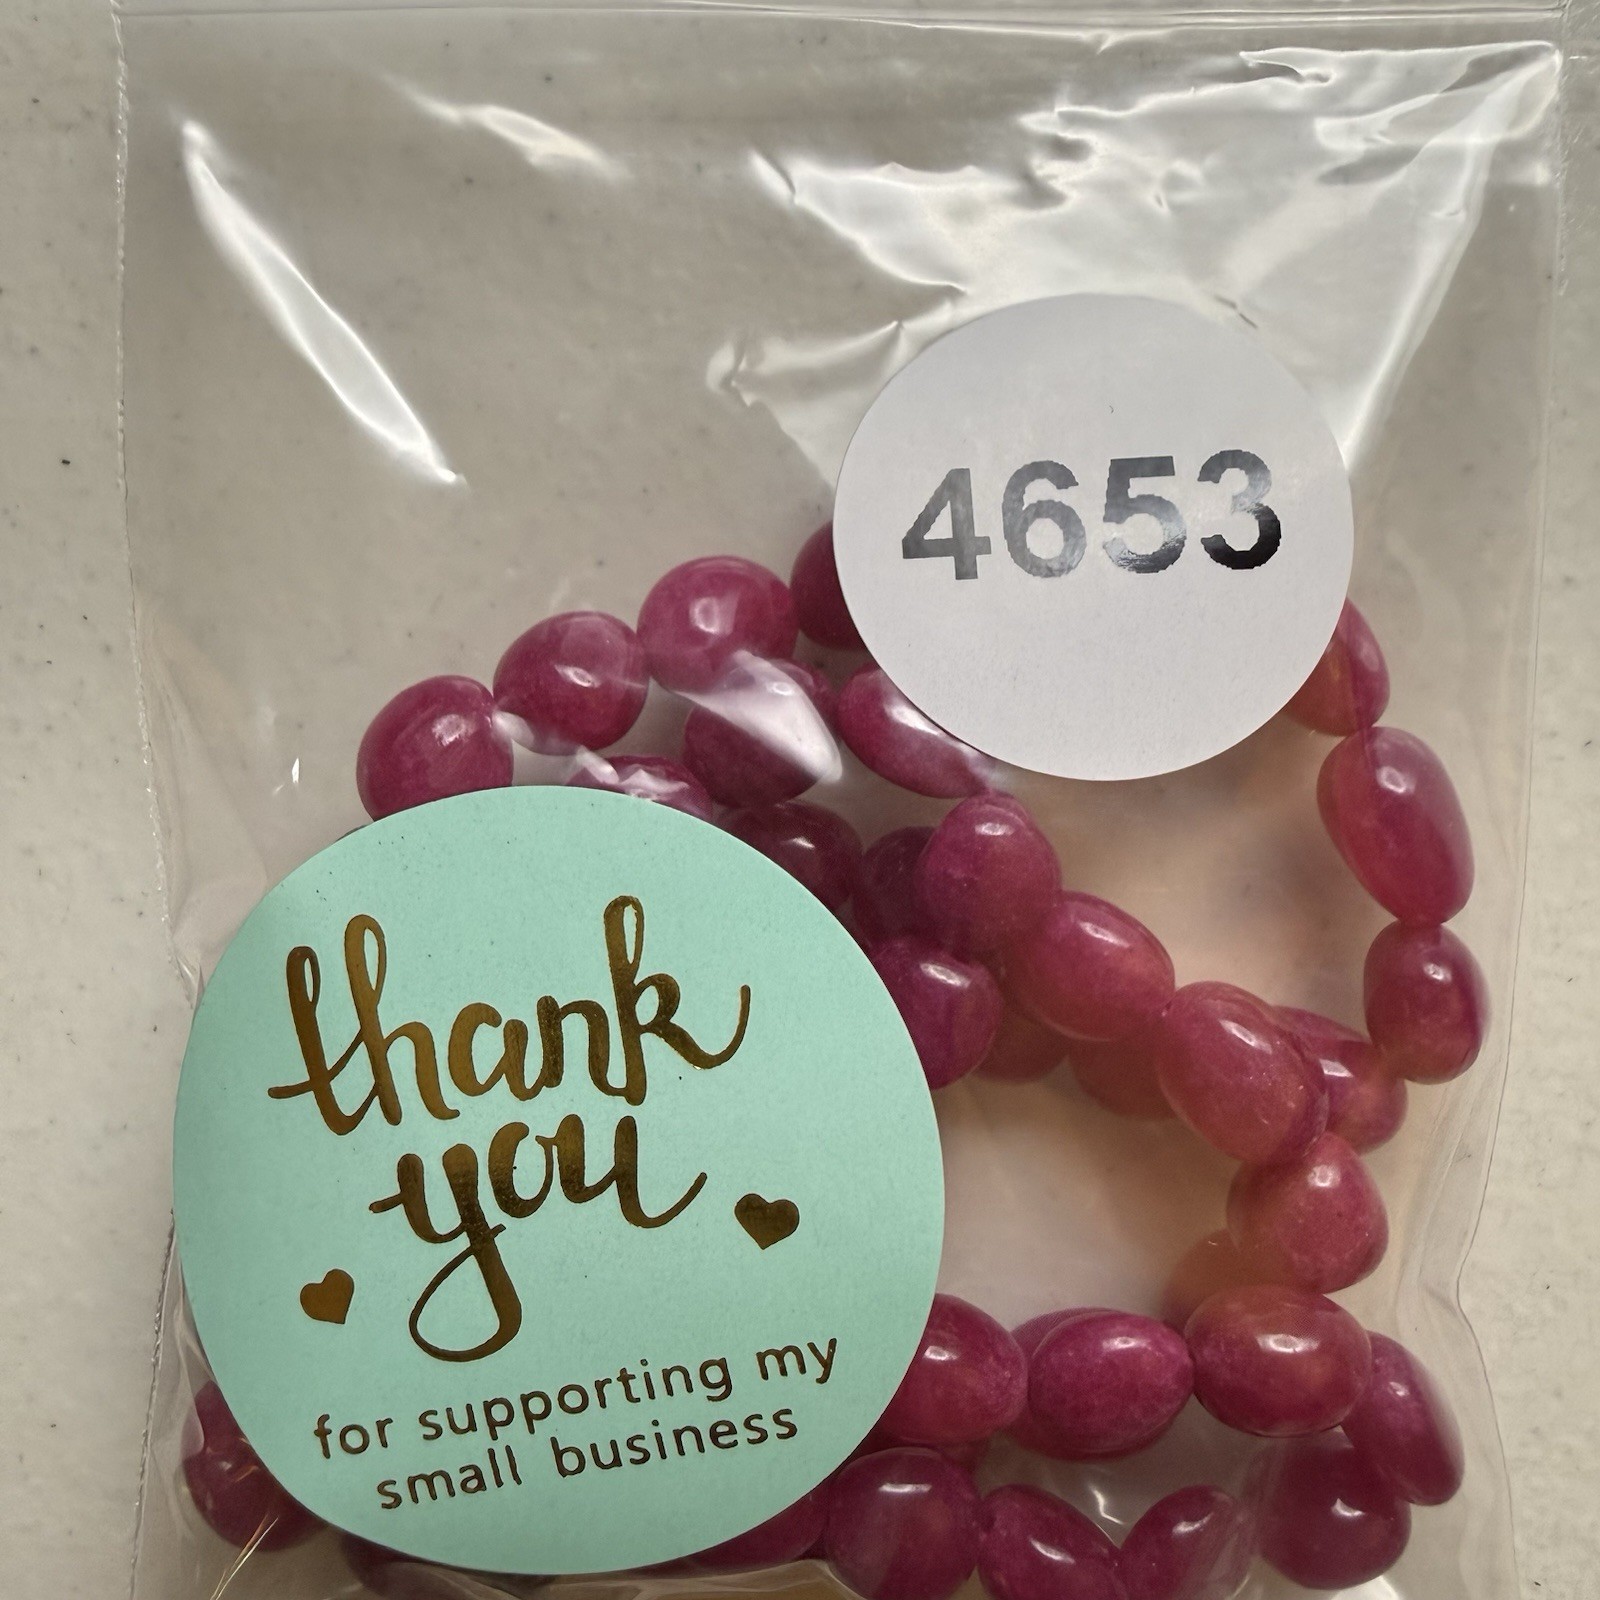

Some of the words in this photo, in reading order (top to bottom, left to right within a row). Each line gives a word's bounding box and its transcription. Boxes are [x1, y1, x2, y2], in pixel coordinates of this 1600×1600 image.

[901, 448, 1282, 580] 4653
[267, 894, 751, 1136] thank
[368, 1113, 708, 1362] you
[313, 1413, 394, 1459] for
[417, 1358, 733, 1440] supporting
[755, 1337, 838, 1384] my
[376, 1444, 523, 1510] small
[549, 1407, 799, 1478] business
